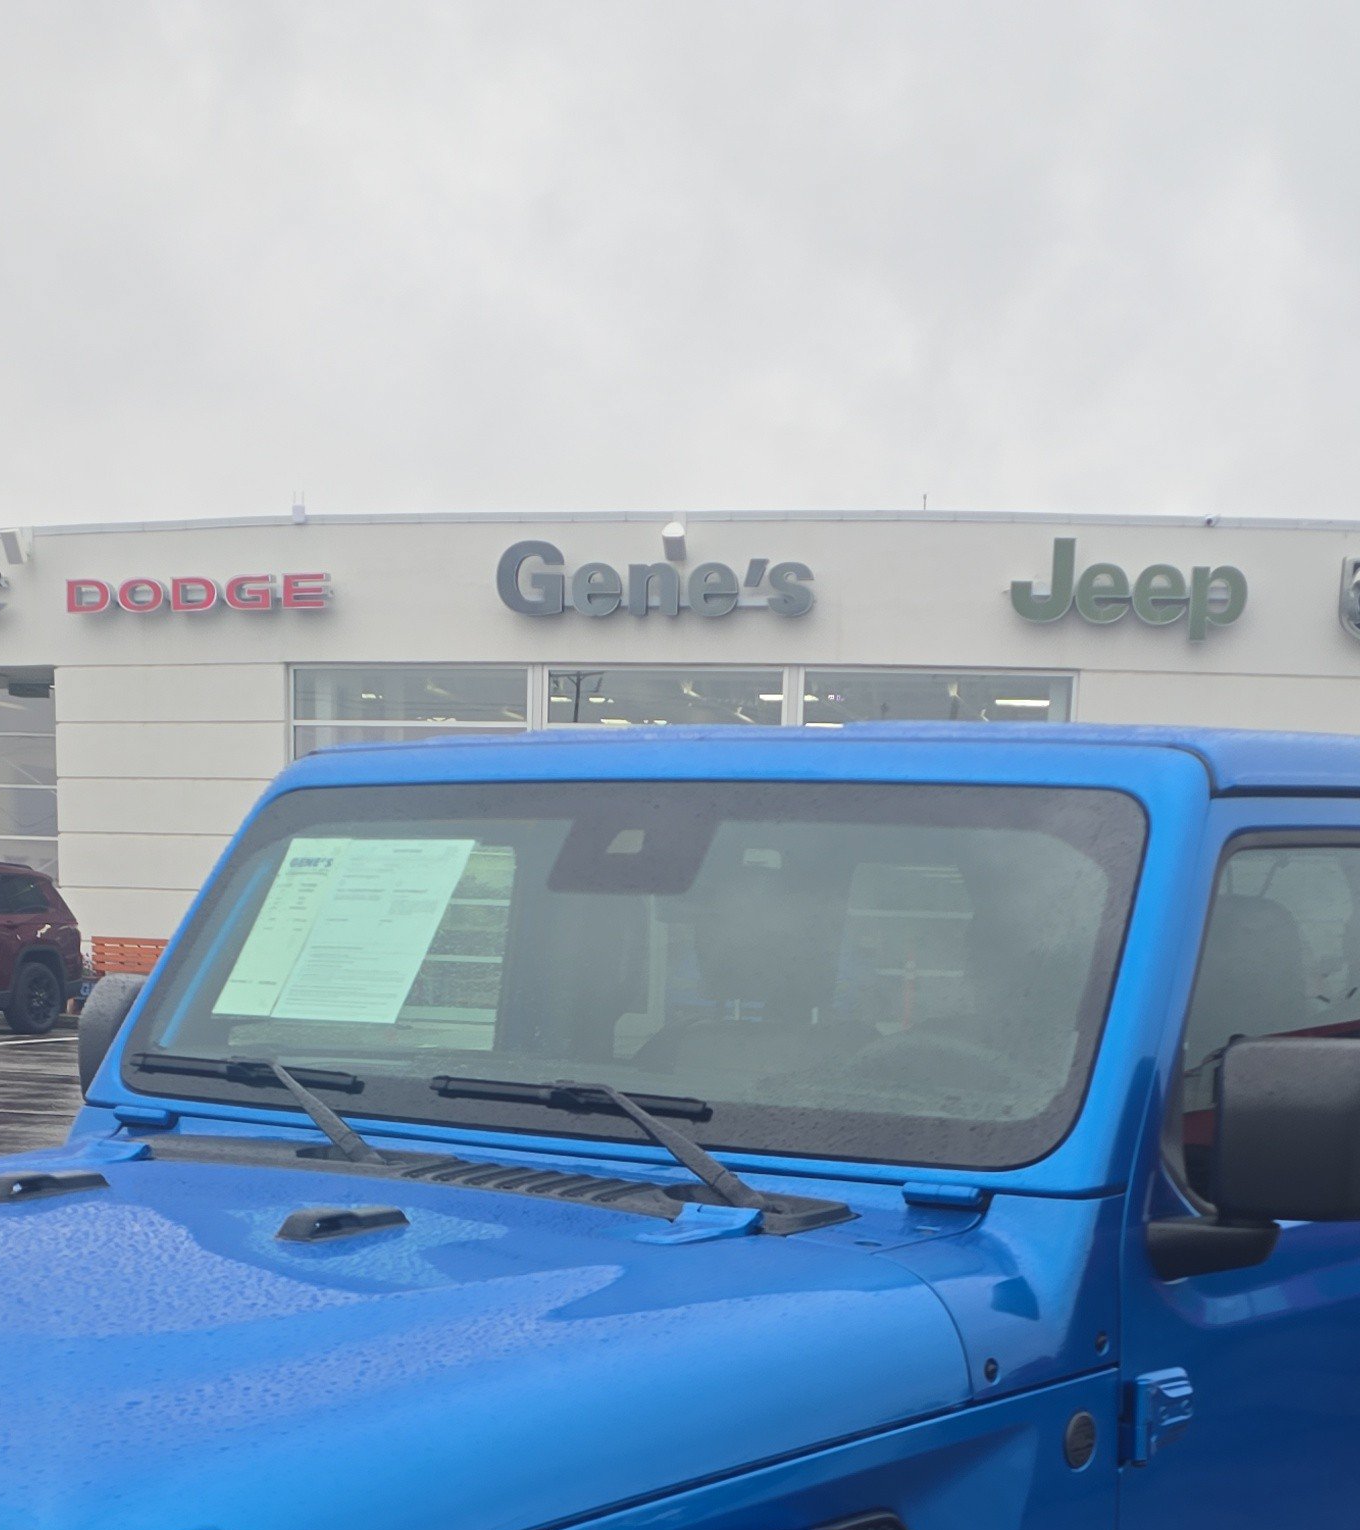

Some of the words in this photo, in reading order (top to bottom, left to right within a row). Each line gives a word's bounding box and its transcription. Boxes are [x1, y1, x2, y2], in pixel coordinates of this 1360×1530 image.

[66, 573, 329, 613] DODGE
[497, 540, 814, 617] Gene's
[1011, 537, 1248, 640] Jeep
